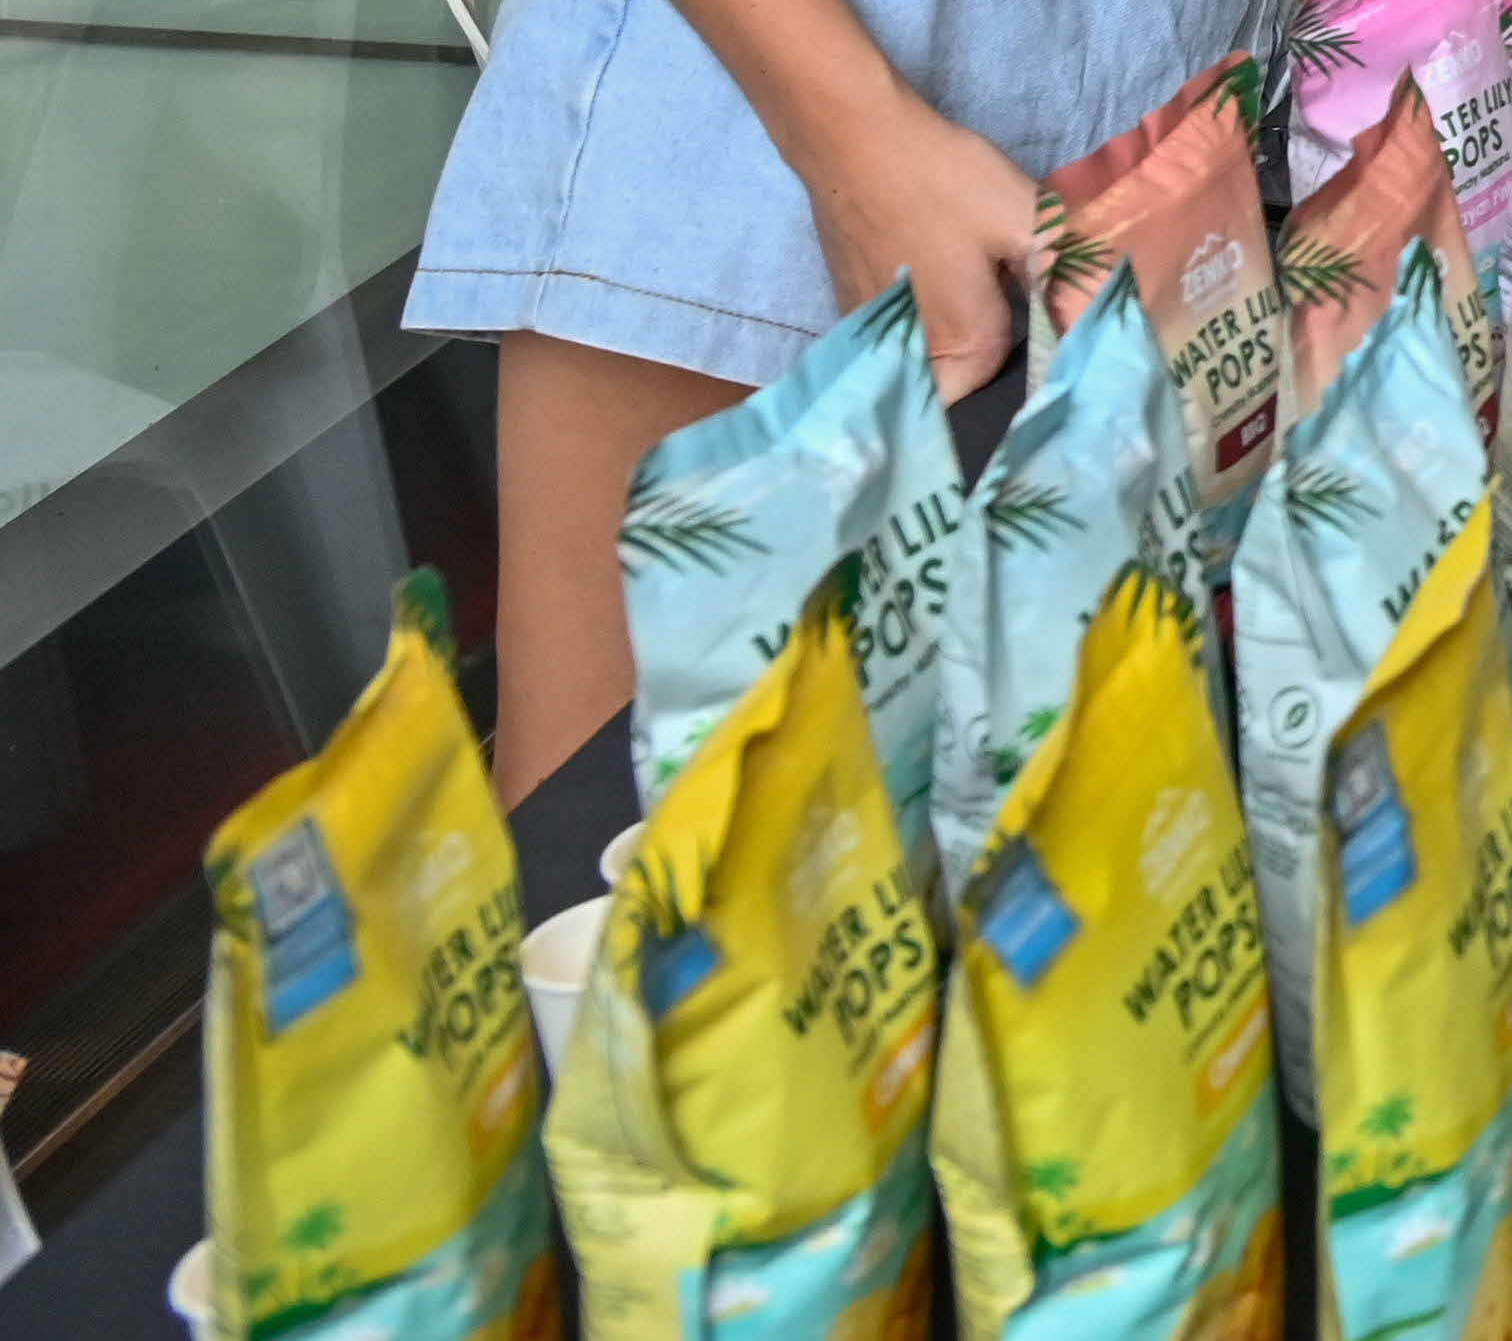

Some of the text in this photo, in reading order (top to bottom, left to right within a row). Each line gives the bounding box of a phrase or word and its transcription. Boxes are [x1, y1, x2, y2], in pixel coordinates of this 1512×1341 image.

[1180, 242, 1246, 304] ZENKO
[1170, 308, 1243, 390] WATER
[1206, 328, 1276, 405] POPS
[832, 920, 925, 1048] POPS
[1124, 887, 1222, 1023] WATER
[1173, 900, 1262, 1031] POPS
